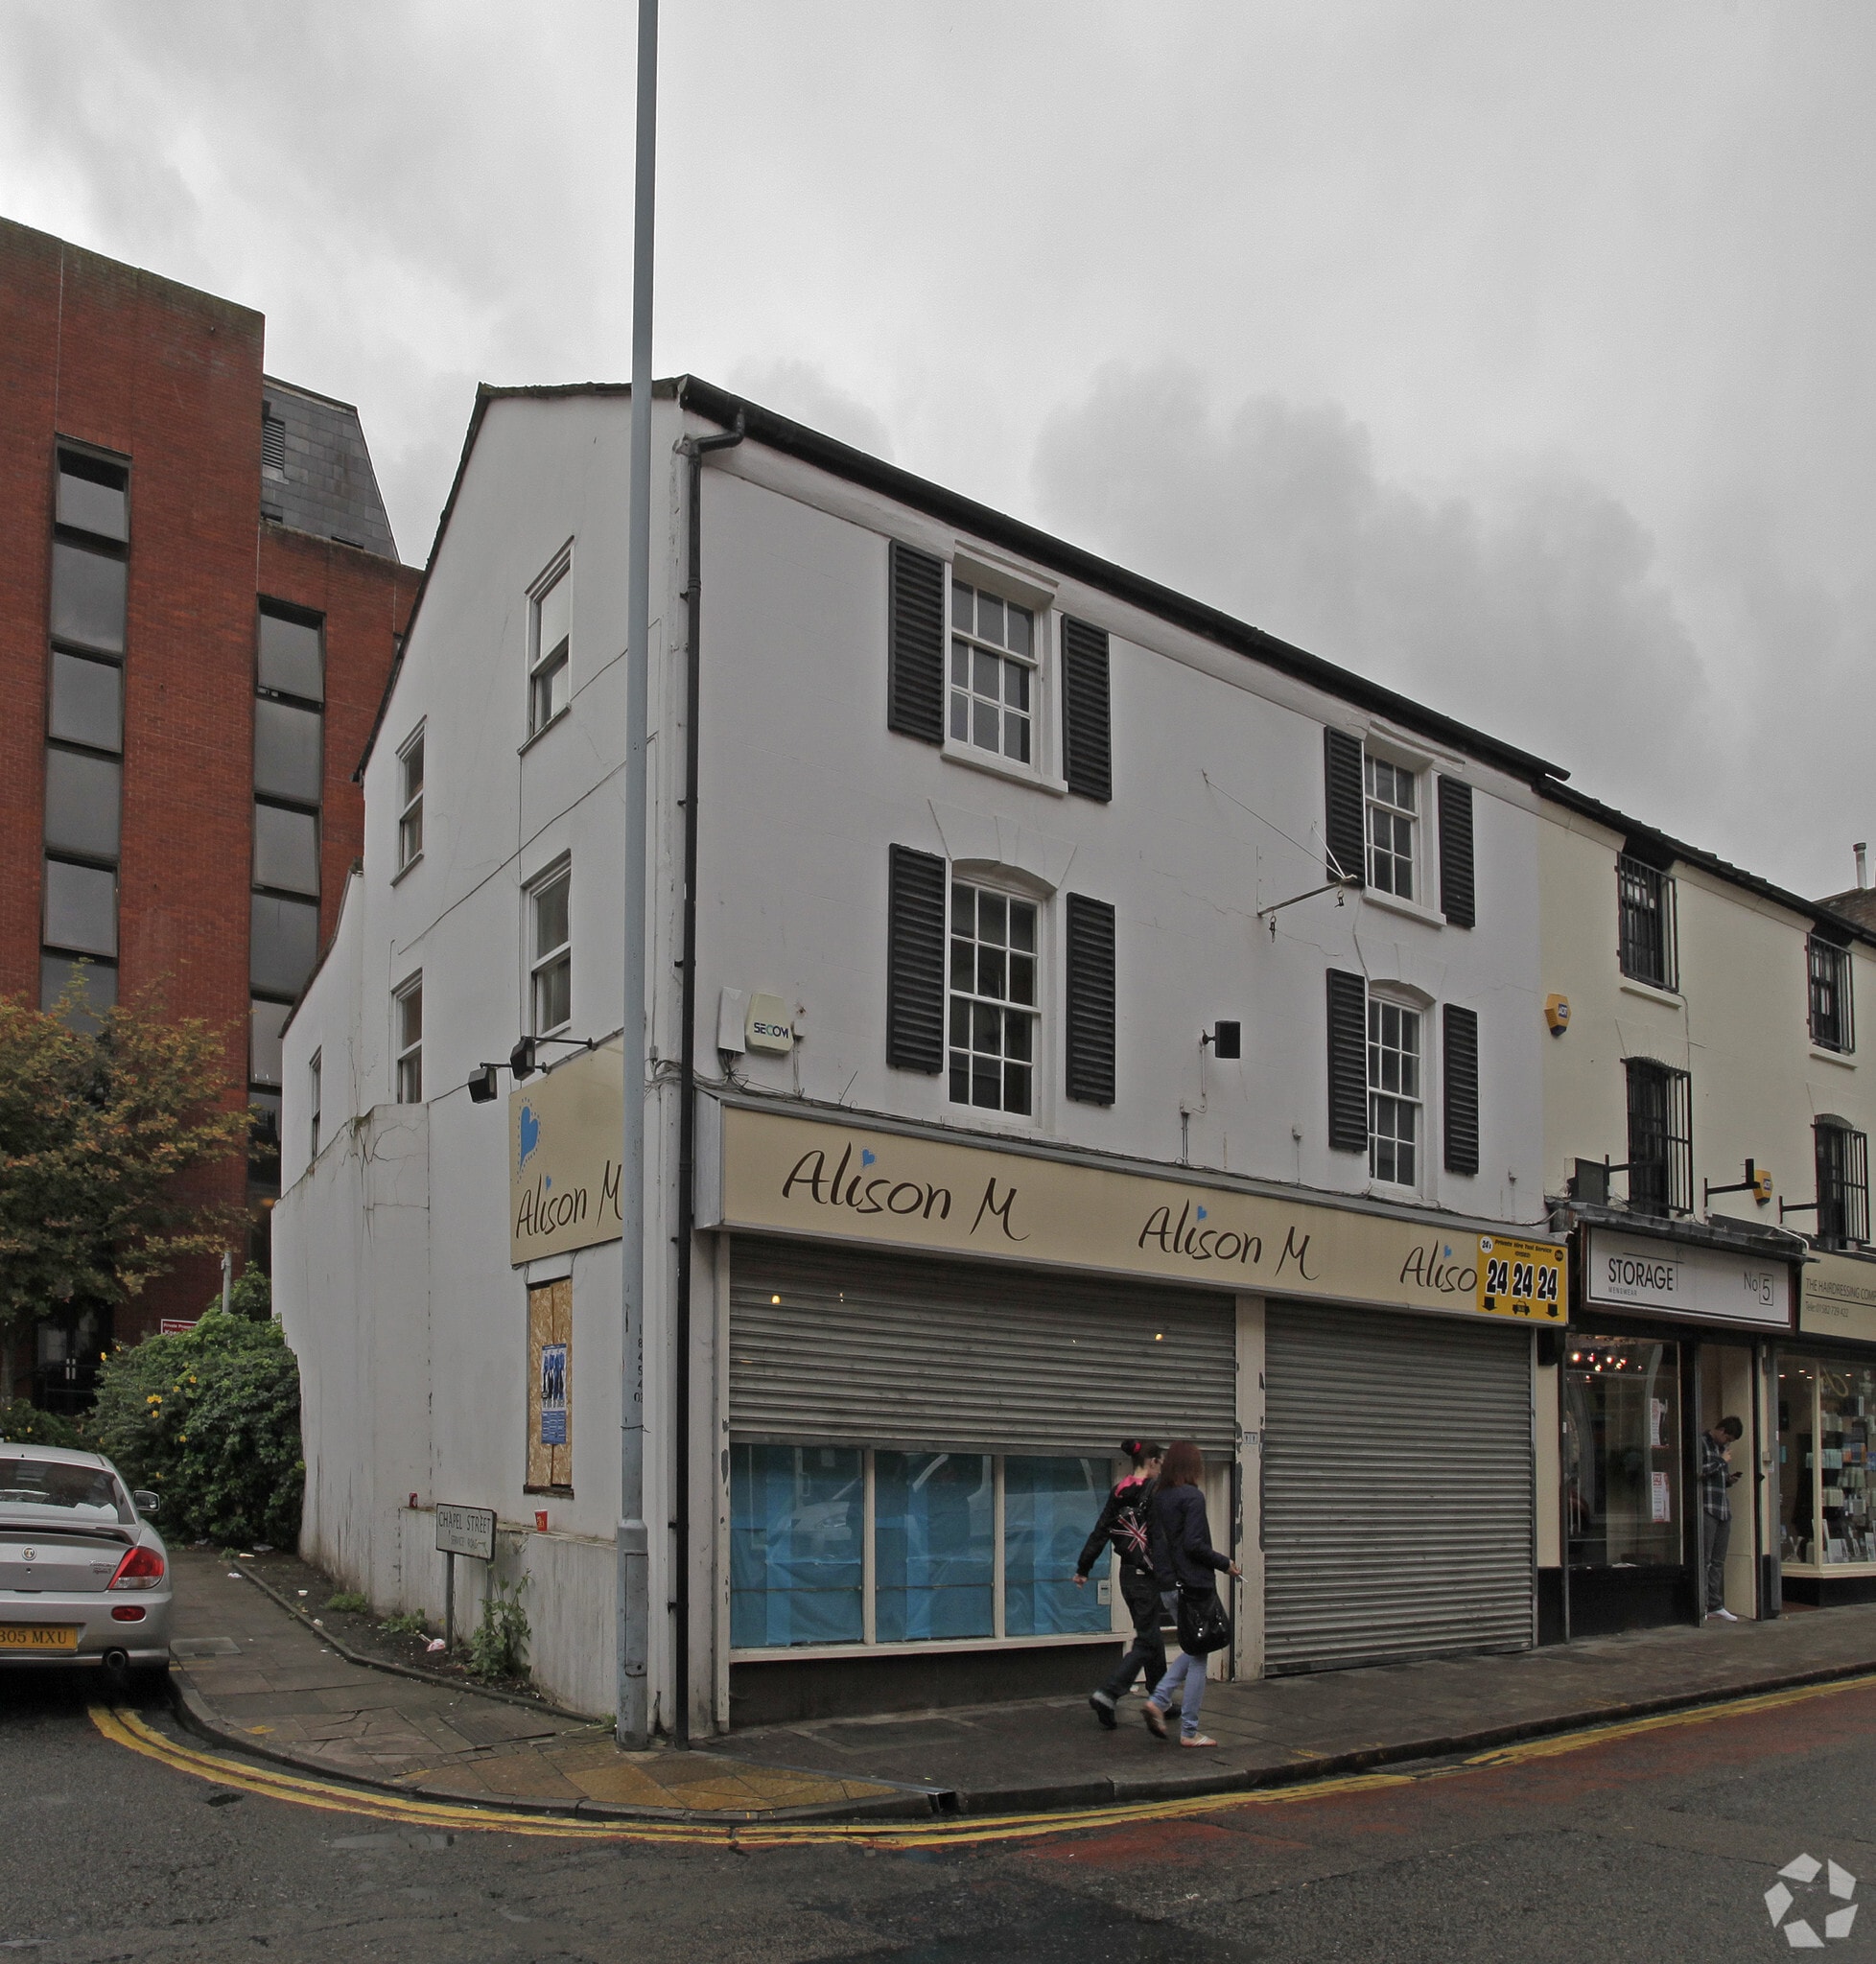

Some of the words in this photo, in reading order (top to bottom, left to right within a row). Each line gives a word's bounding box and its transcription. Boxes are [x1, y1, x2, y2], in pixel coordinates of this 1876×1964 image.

[754, 1021, 789, 1039] SECOM
[516, 1173, 587, 1239] Alison
[597, 1159, 623, 1228] M
[782, 1141, 951, 1220] Alison
[970, 1177, 1031, 1241] M
[1137, 1198, 1262, 1264] Alison
[1275, 1226, 1321, 1281] M
[1486, 1258, 1509, 1296] 24
[1512, 1262, 1534, 1298] 24
[1536, 1265, 1559, 1302] 24
[1608, 1257, 1674, 1292] STORAGE
[1744, 1271, 1758, 1292] No
[1762, 1278, 1770, 1301] 5
[1805, 1277, 1817, 1292] THE
[1818, 1281, 1860, 1298] HAIRDRESSING
[439, 1511, 462, 1530] CHAPEL
[467, 1515, 490, 1533] STREET
[32, 1630, 67, 1644] MXU
